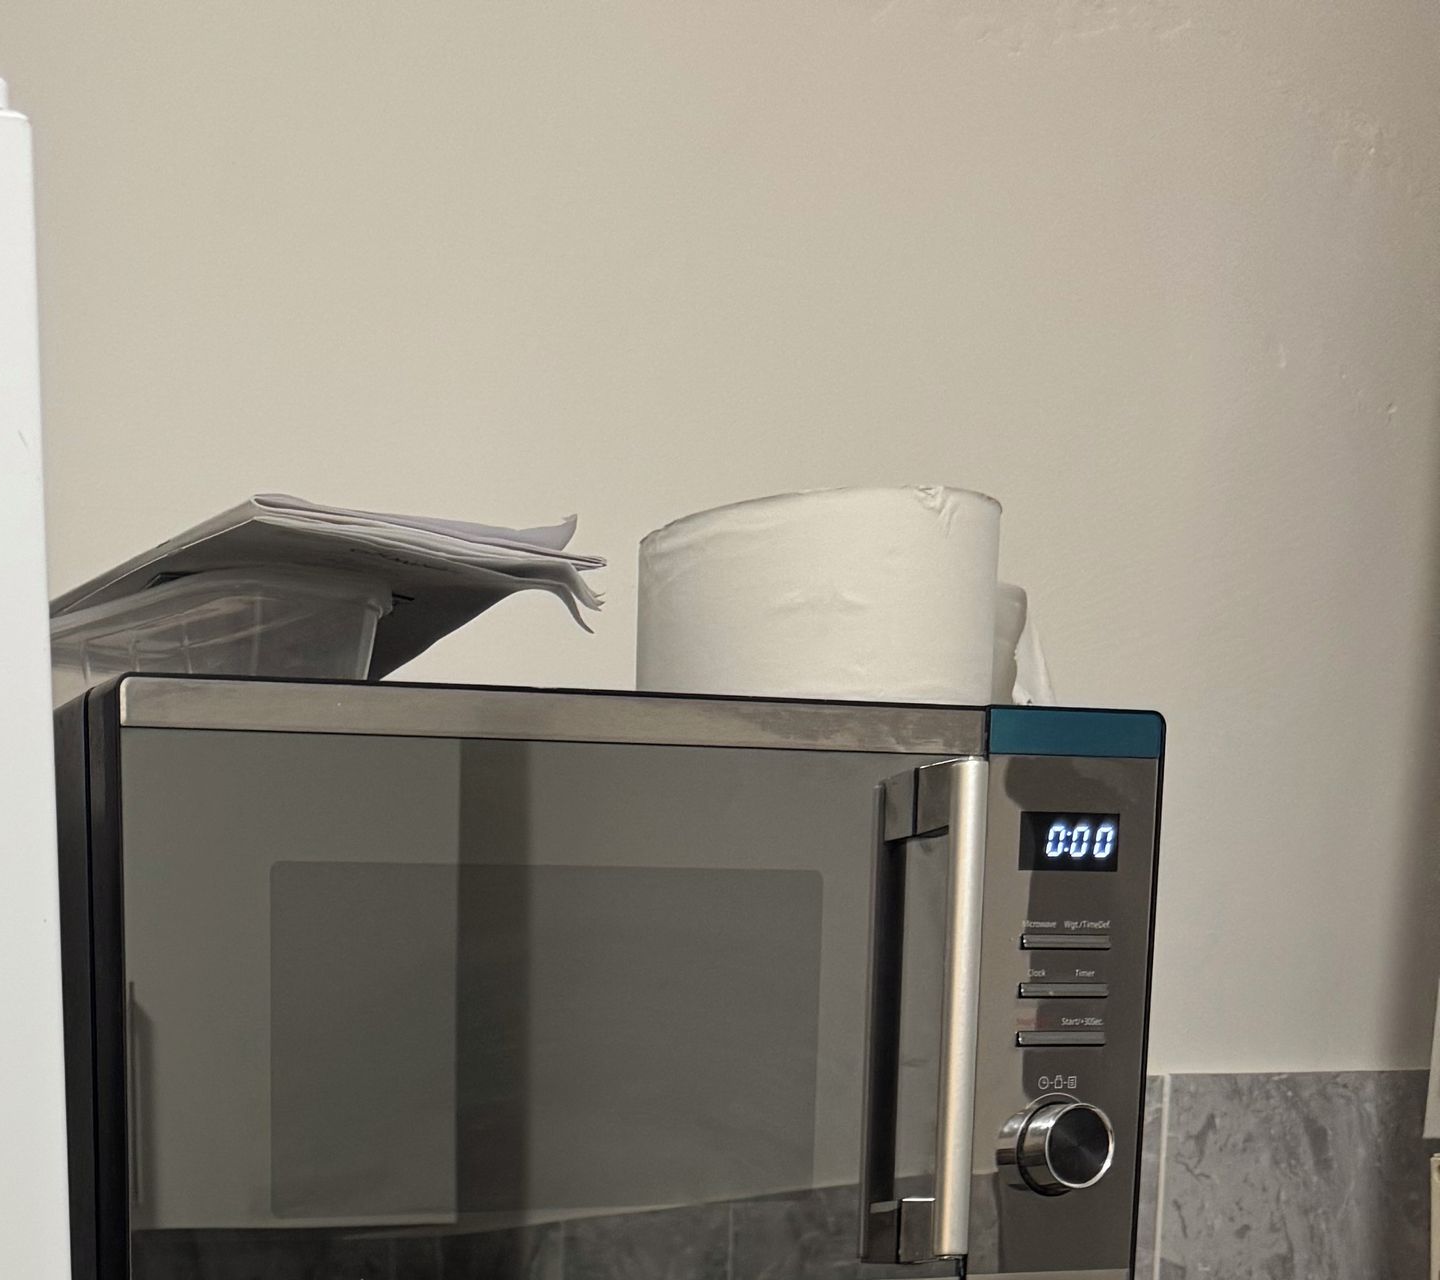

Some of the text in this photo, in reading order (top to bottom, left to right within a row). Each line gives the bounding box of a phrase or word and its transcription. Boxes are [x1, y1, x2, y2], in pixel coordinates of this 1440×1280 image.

[1045, 825, 1114, 858] 0:00
[1027, 969, 1046, 977] Clock
[1075, 969, 1095, 977] Timer
